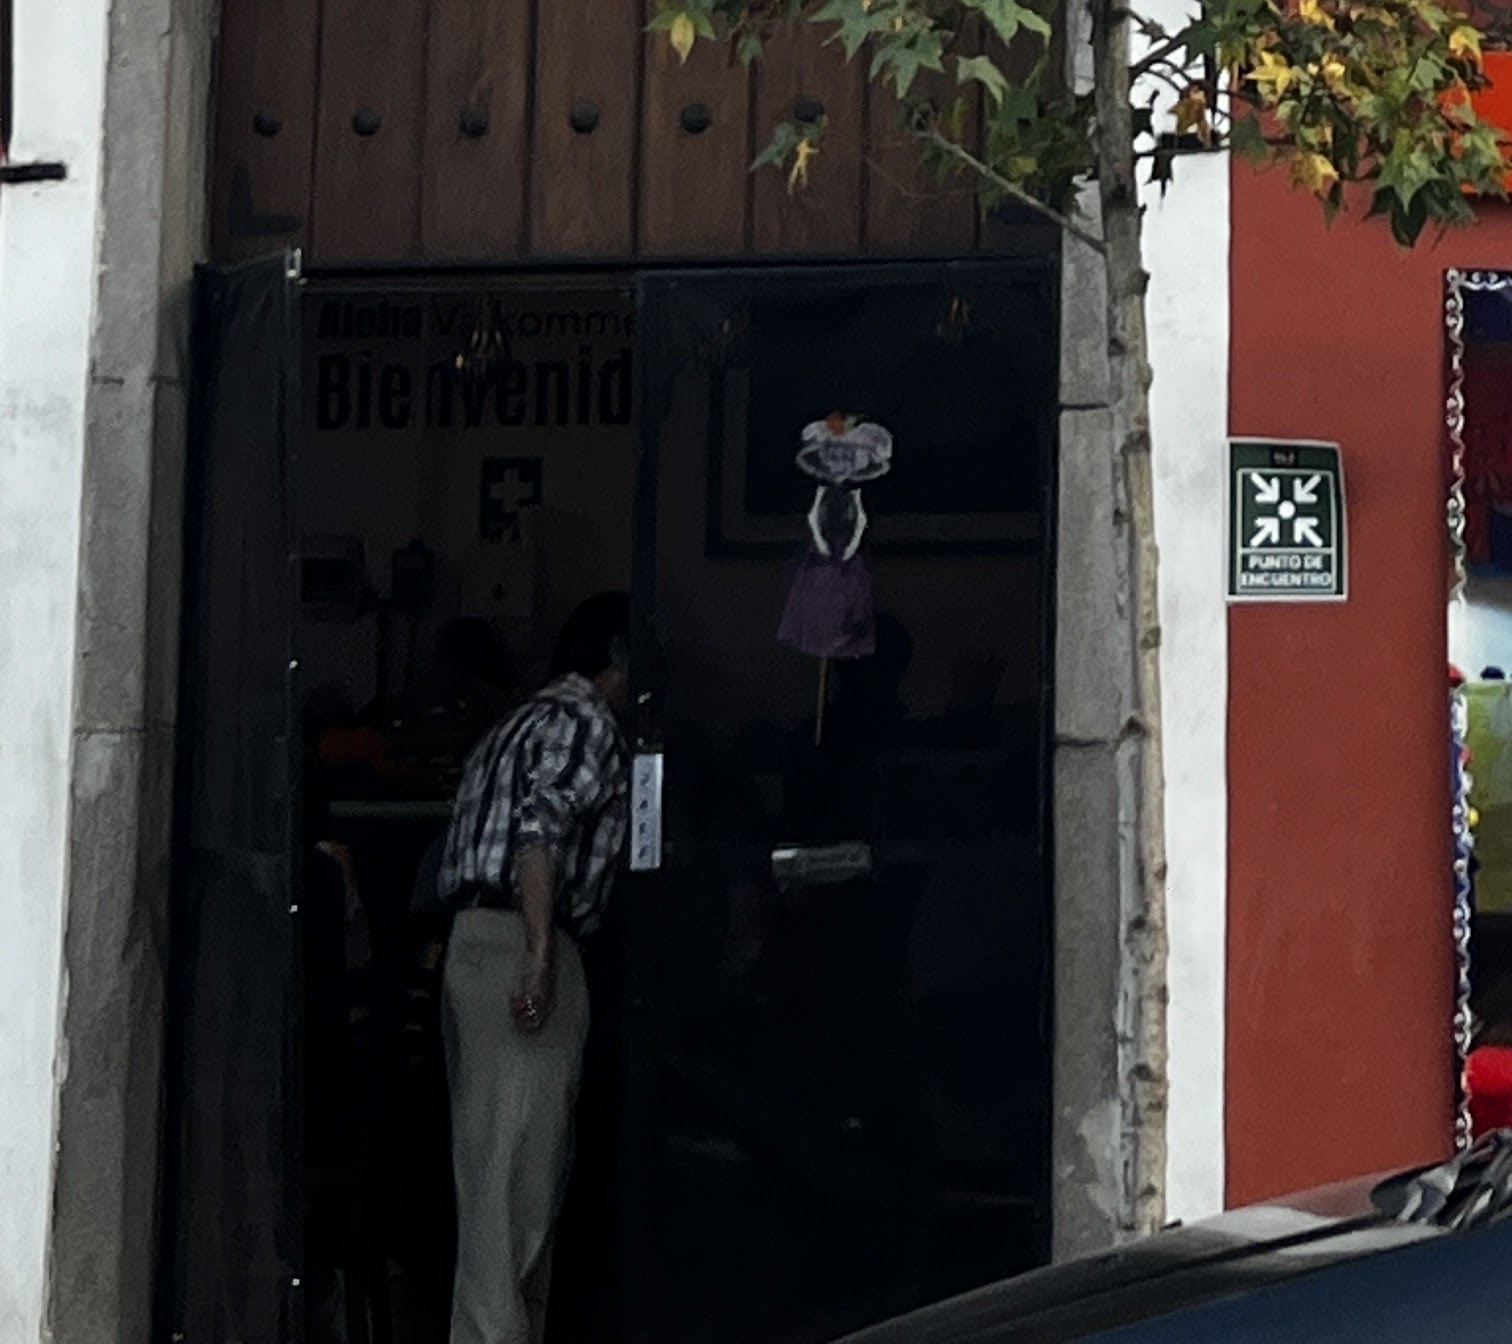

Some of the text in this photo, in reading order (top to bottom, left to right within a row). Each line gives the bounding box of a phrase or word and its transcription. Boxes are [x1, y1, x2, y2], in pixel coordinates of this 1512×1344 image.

[1248, 553, 1323, 570] PUNTO DE
[1241, 572, 1332, 587] ENCUENTRO
